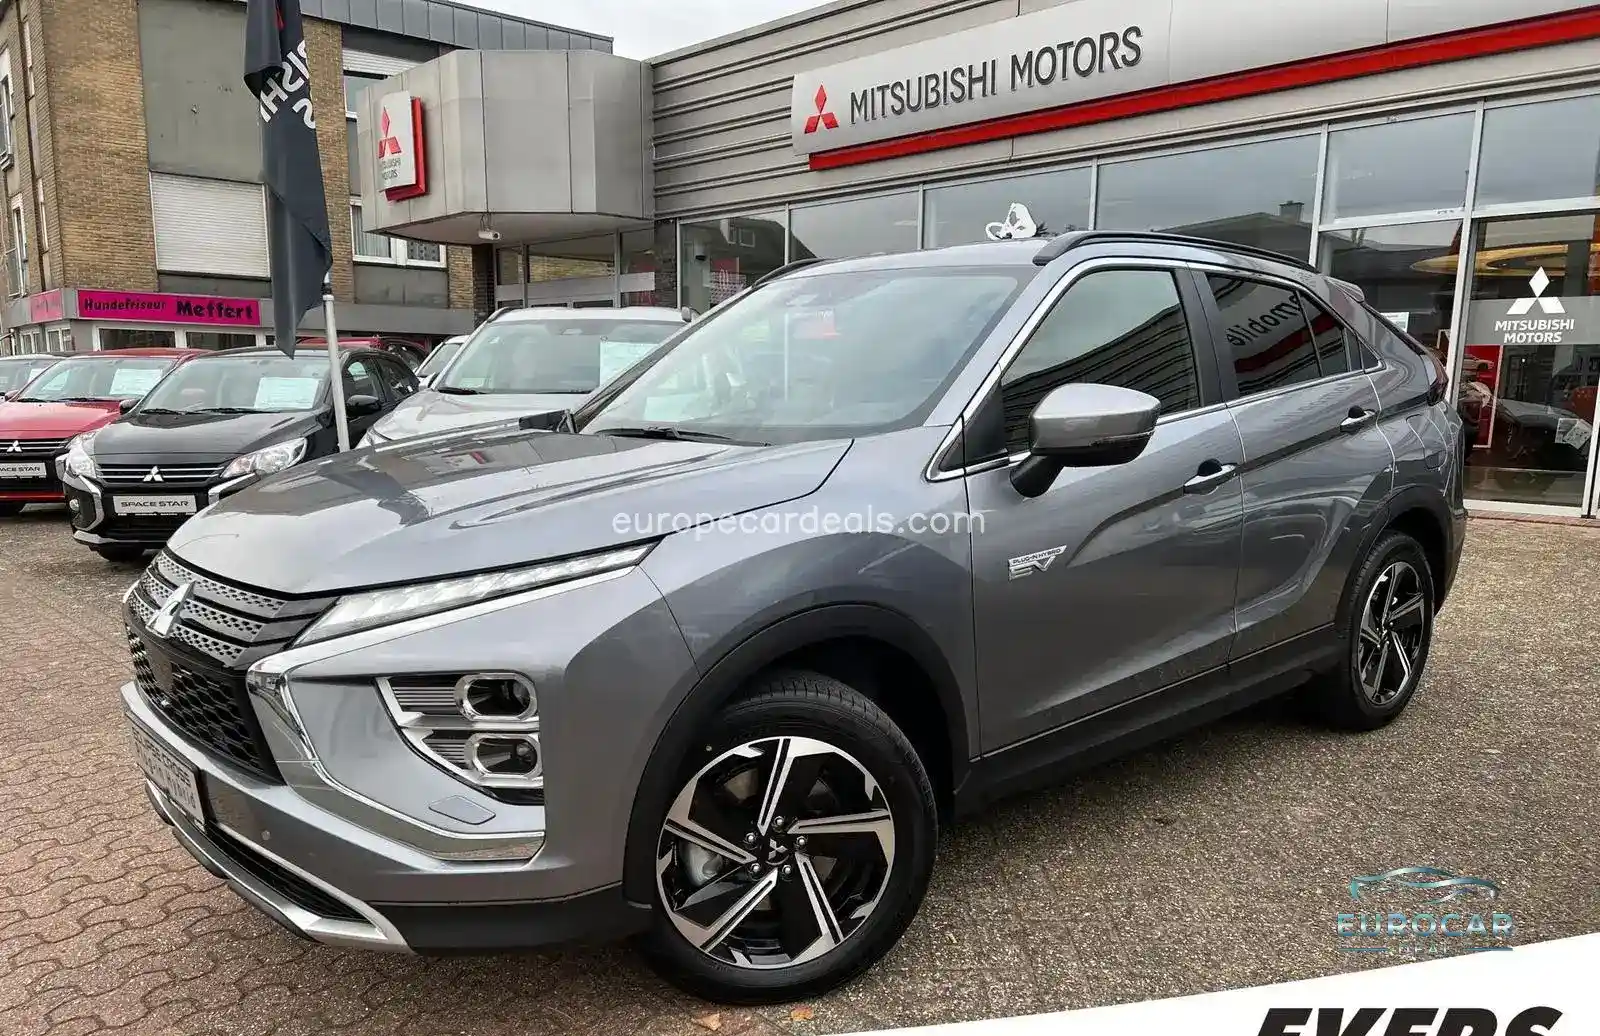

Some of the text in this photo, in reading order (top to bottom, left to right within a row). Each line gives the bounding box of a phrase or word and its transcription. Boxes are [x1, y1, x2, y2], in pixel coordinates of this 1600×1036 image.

[850, 25, 1142, 124] MITSUBISHI MOTORS
[84, 298, 166, 311] Hundefriseur
[176, 300, 254, 318] Meffert
[1495, 319, 1575, 331] MITSUBISHI
[1503, 332, 1562, 343] MOTORS
